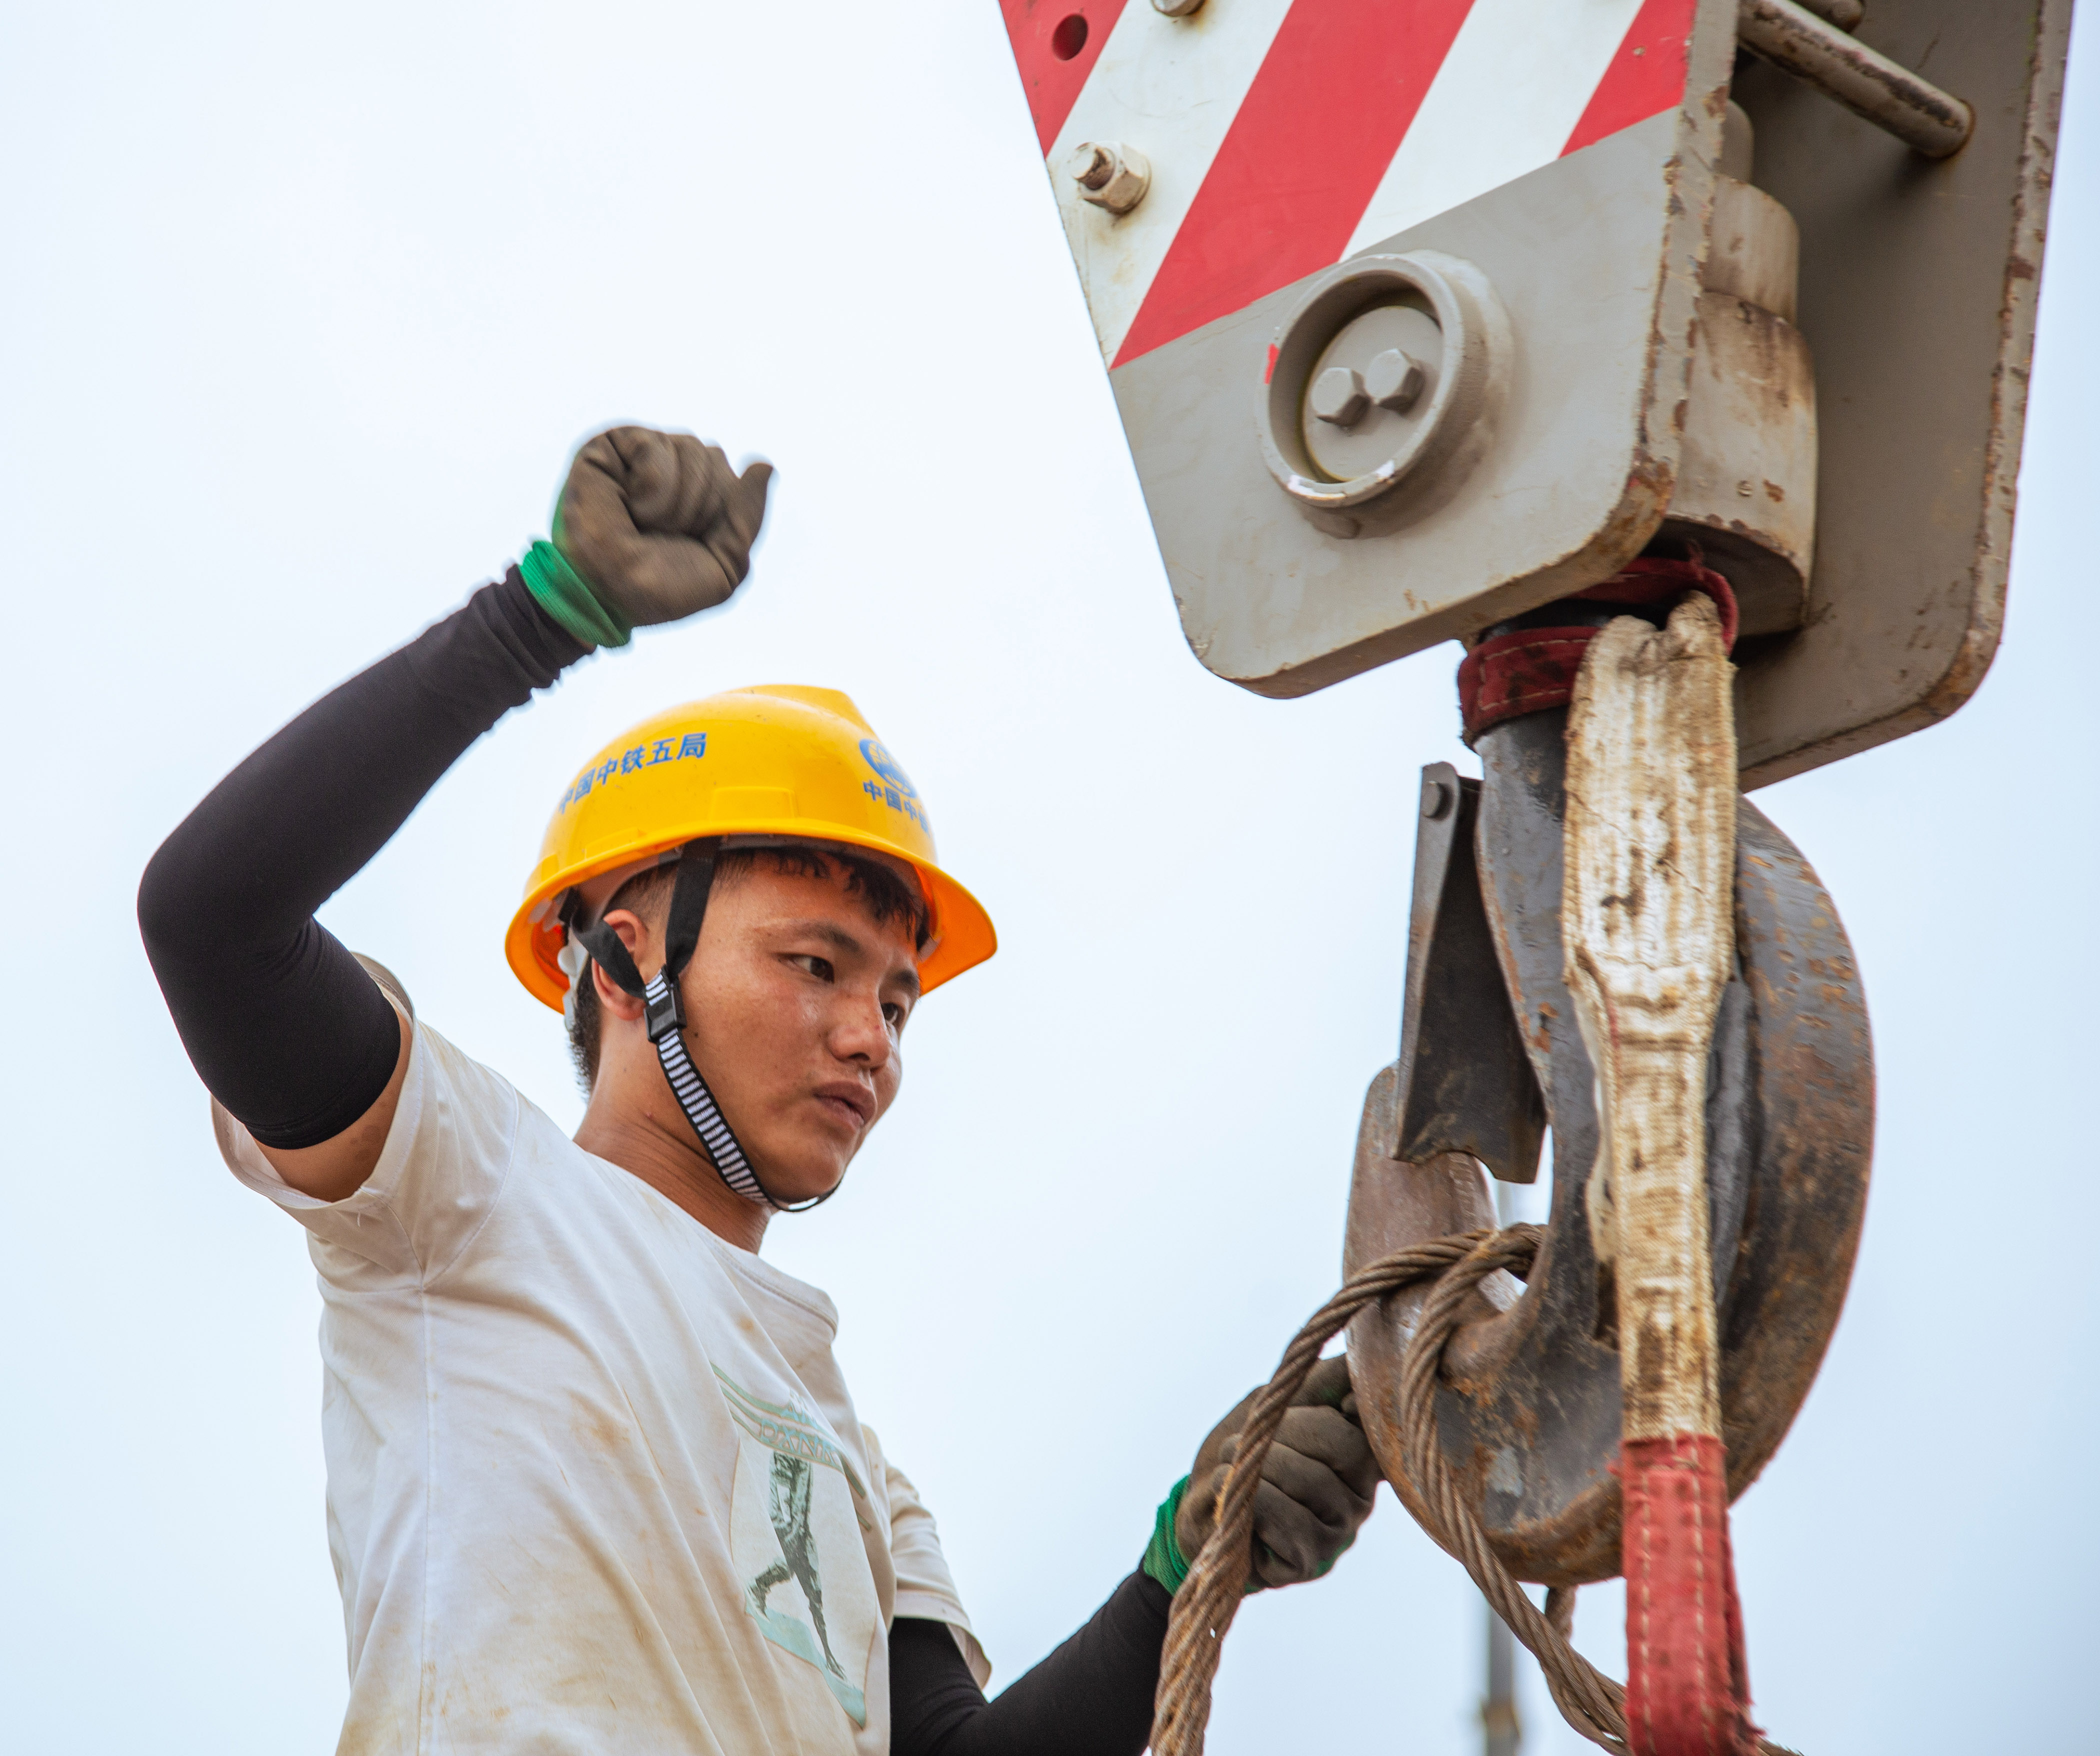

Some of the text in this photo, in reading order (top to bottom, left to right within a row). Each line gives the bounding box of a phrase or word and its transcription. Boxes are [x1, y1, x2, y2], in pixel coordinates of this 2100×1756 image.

[558, 732, 706, 814] 中国中铁五局
